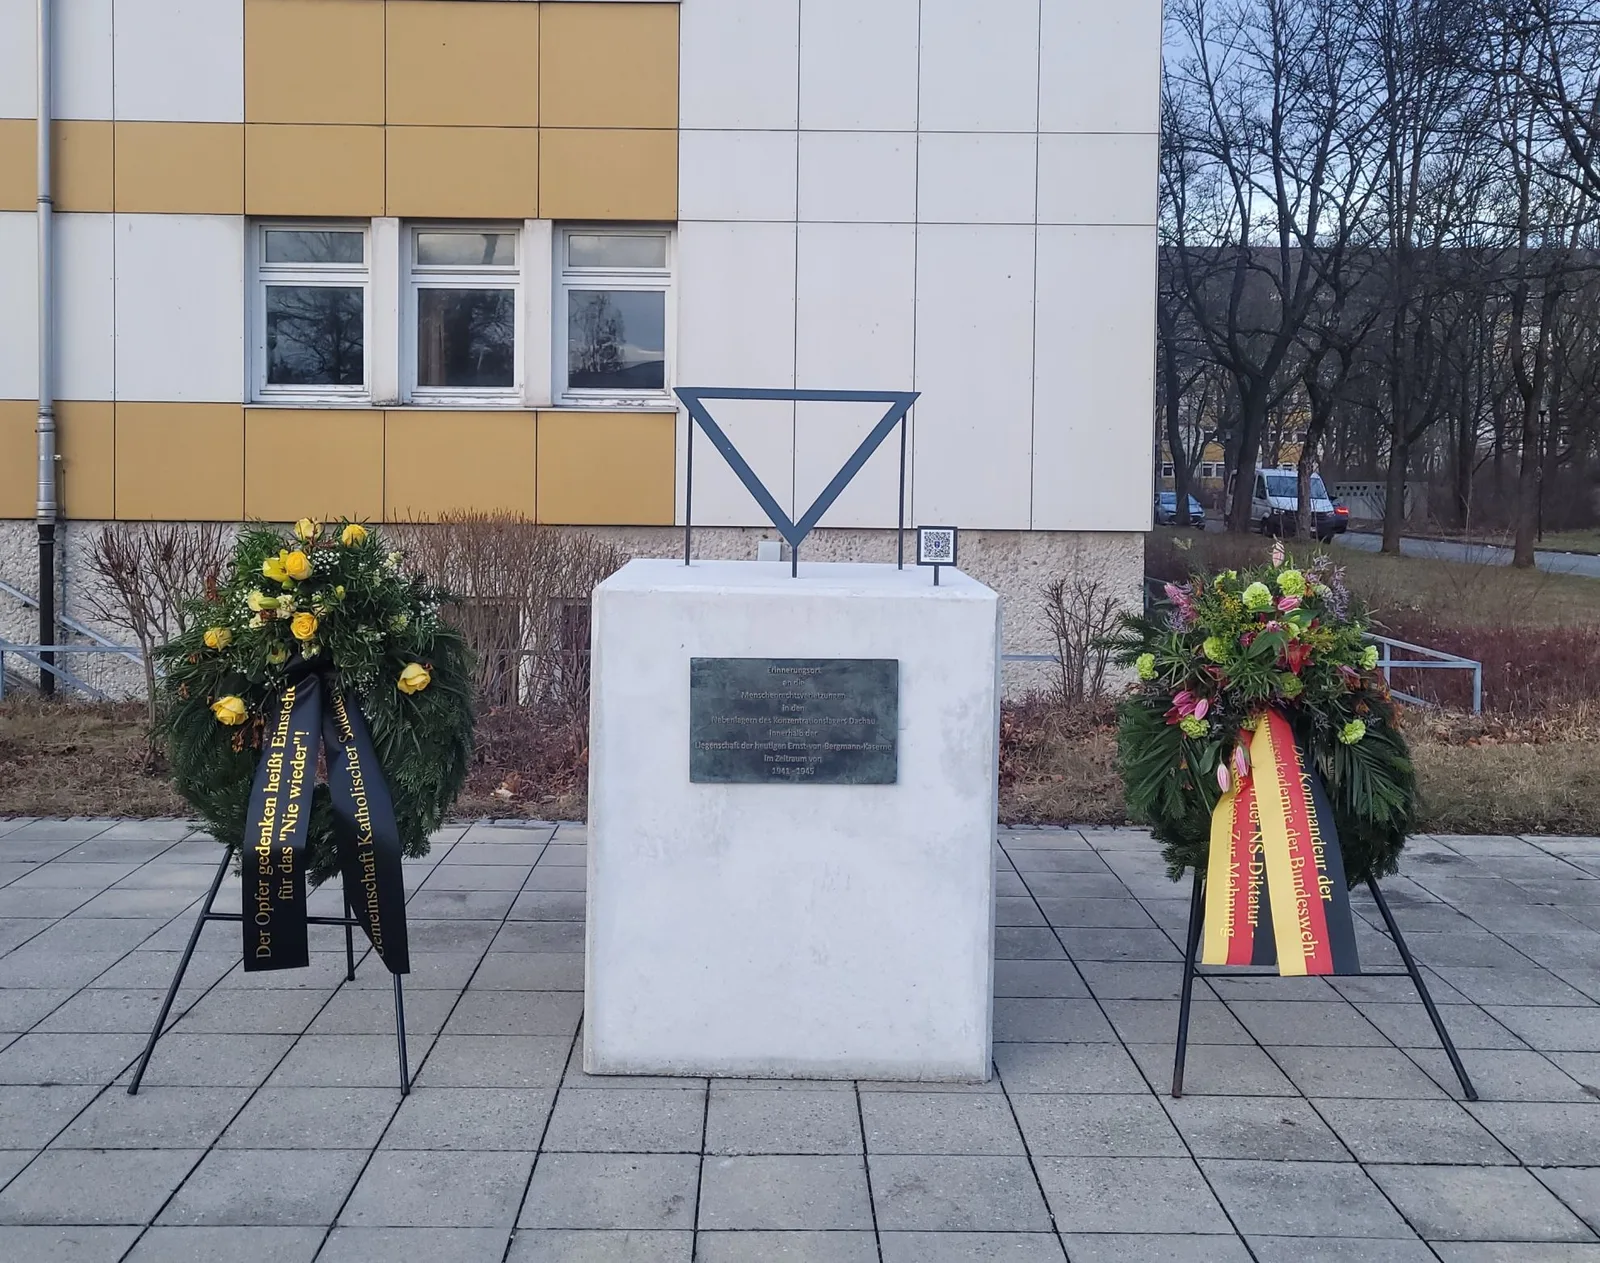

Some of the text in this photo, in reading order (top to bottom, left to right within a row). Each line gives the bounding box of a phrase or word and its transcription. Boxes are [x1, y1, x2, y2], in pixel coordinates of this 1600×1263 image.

[767, 666, 821, 676] Erinnerungsort
[849, 717, 876, 725] Dachau
[263, 751, 284, 794] heißt
[774, 755, 807, 763] Zeitraum
[796, 767, 815, 775] 1945
[345, 745, 373, 848] Katholischer
[254, 796, 277, 877] gedenken
[1285, 826, 1301, 852] der
[1292, 744, 1334, 902] Der Kommandeur der
[278, 846, 294, 874] das
[278, 876, 294, 901] für
[1248, 830, 1264, 927] NS-Diktatur
[254, 879, 275, 925] Opfer
[1220, 861, 1241, 938] Mahnung
[1290, 855, 1319, 959] Bundeswehr
[255, 931, 272, 959] Der
